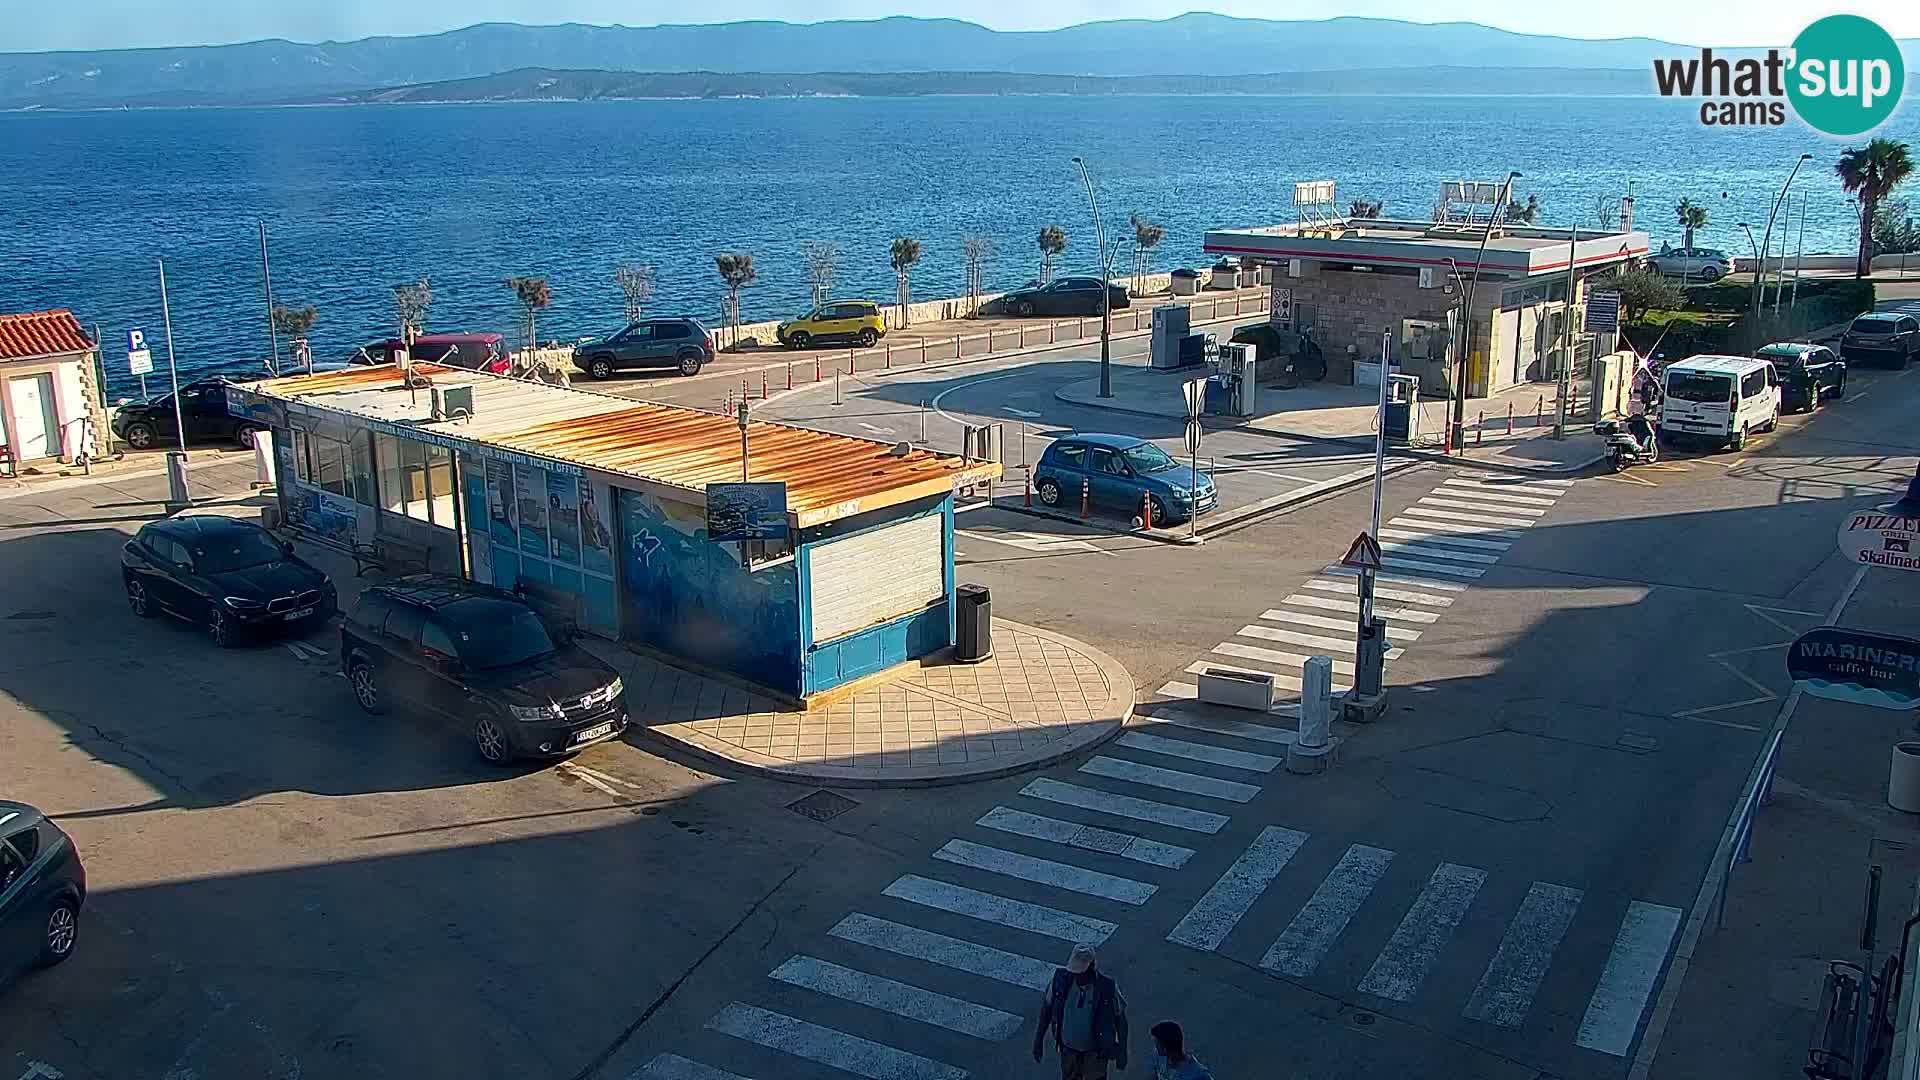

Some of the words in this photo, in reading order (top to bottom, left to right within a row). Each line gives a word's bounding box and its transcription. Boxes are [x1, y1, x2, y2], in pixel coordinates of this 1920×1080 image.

[131, 330, 144, 350] P
[480, 447, 493, 457] BUS
[496, 450, 526, 464] STATION
[530, 457, 554, 470] TICKET
[557, 462, 584, 476] OFFICE
[1869, 665, 1896, 680] bar
